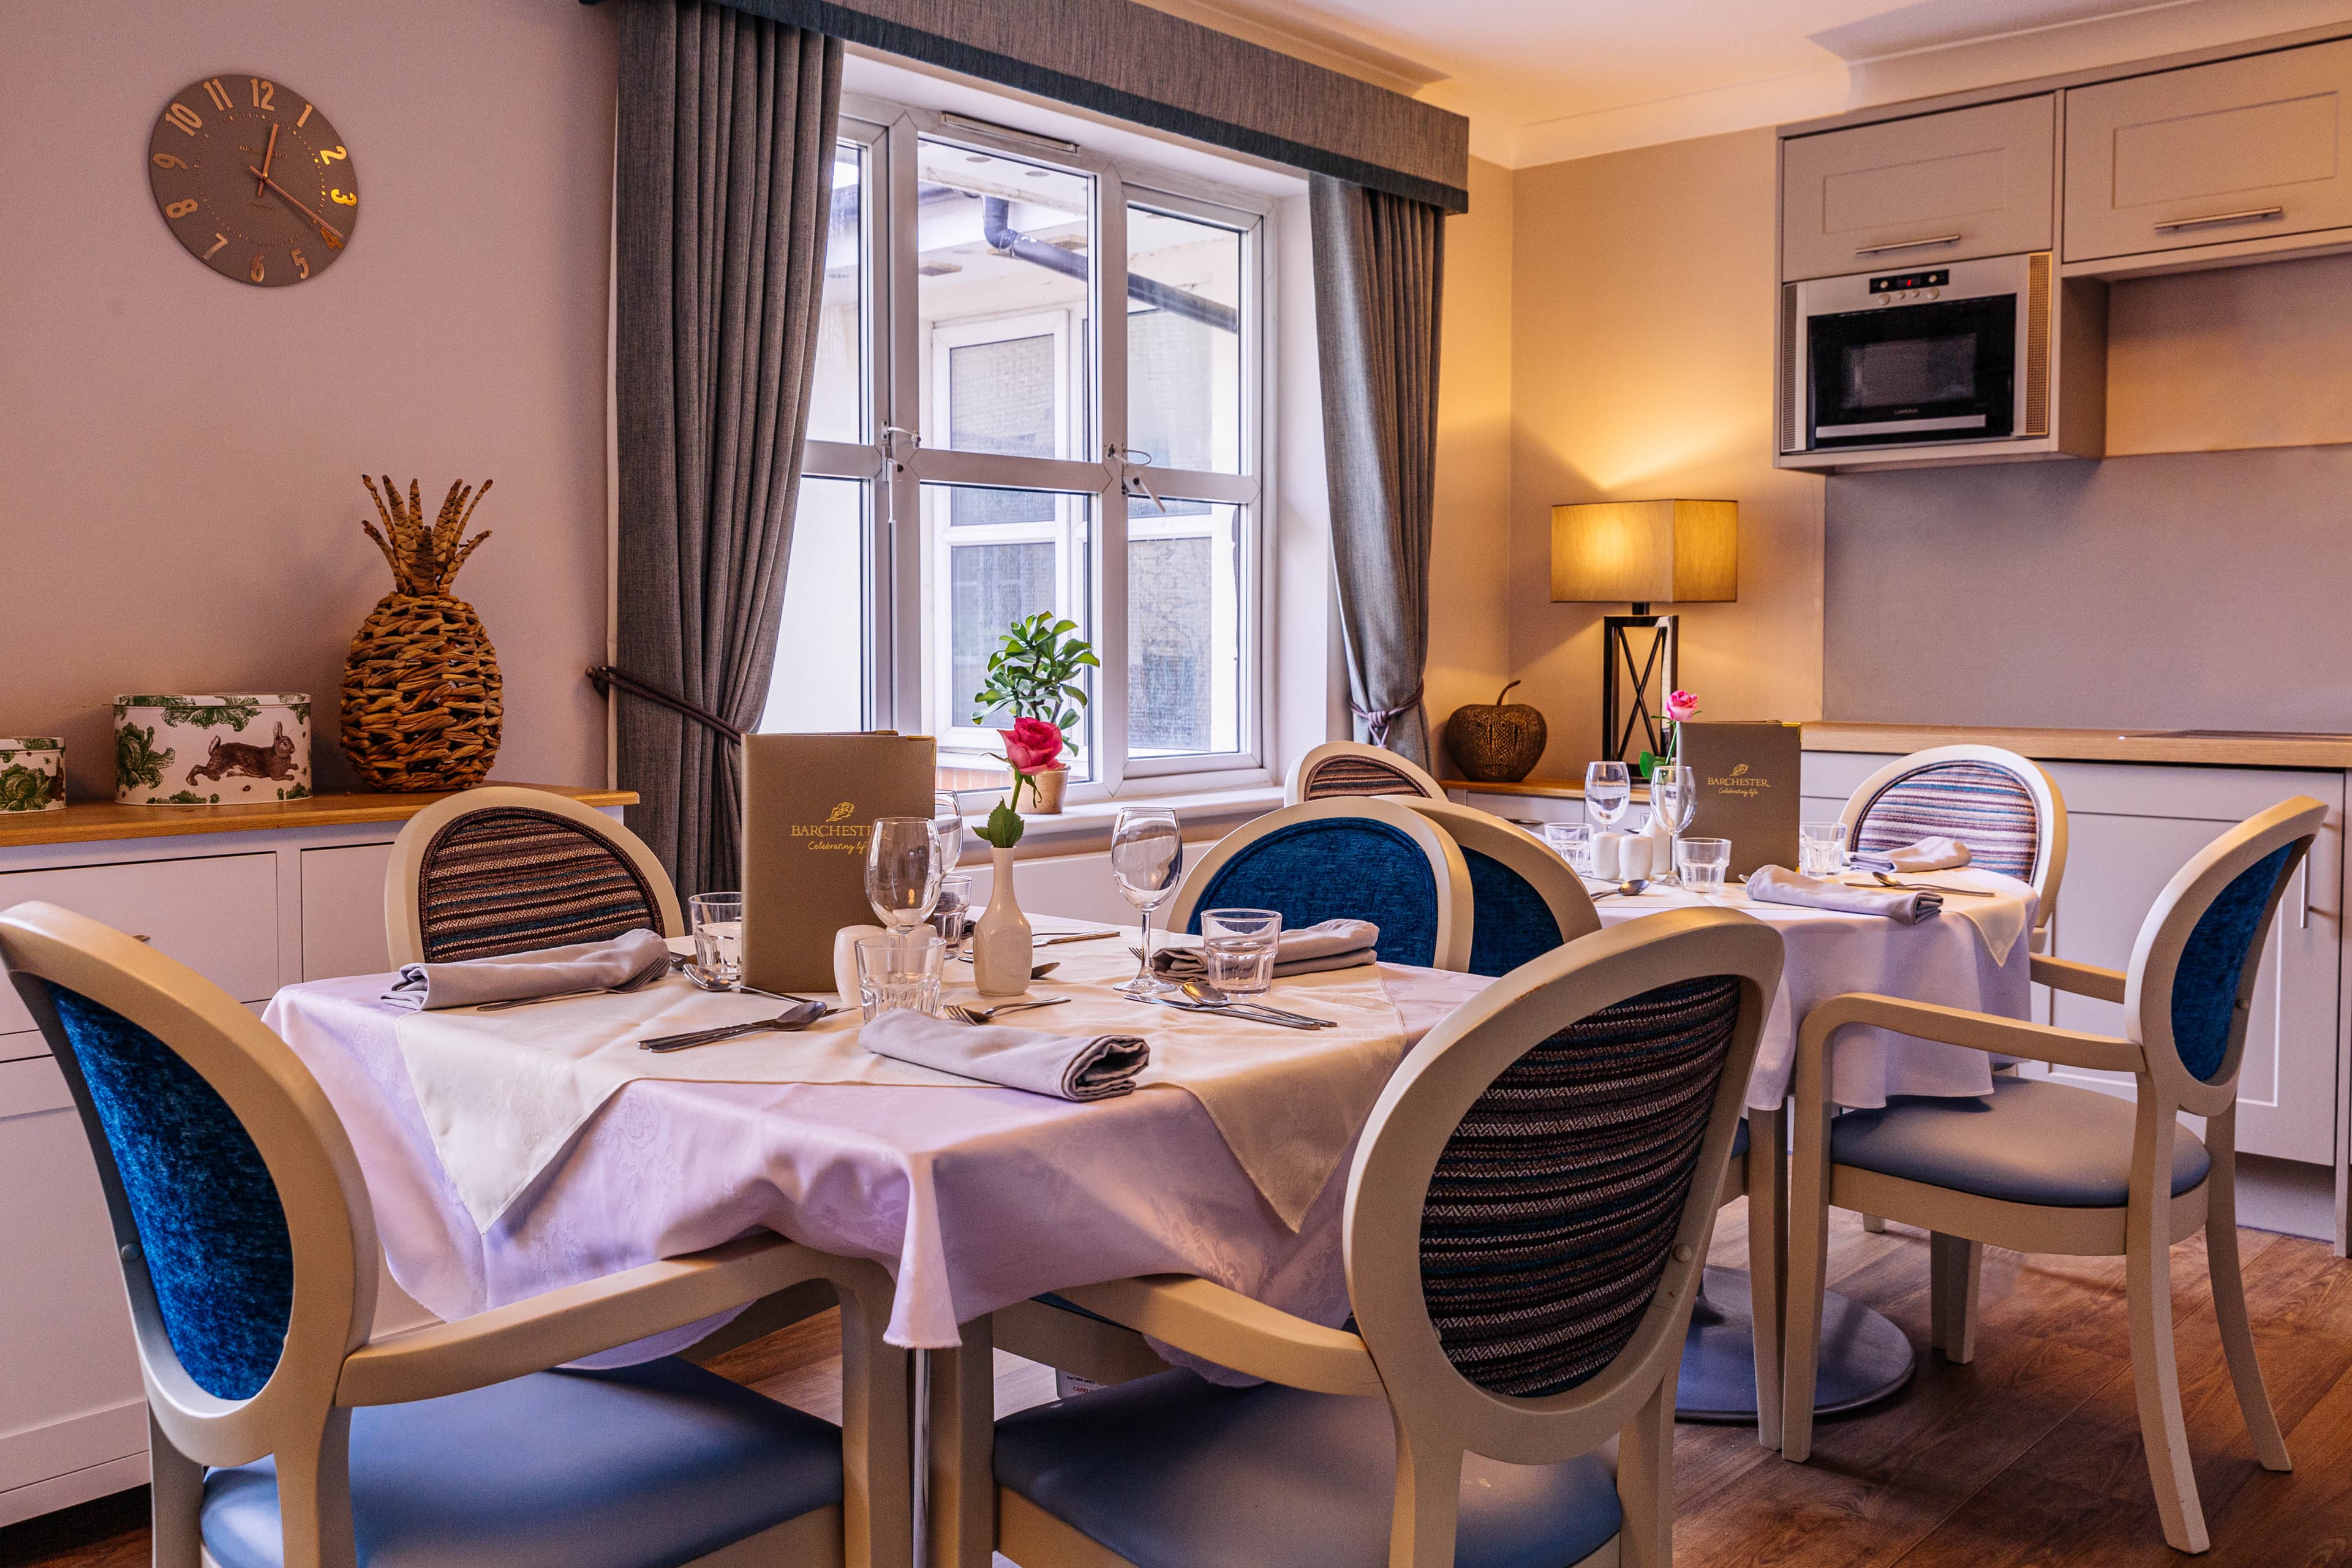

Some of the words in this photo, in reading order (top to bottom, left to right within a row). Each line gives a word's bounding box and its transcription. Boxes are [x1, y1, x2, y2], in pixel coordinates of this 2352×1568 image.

[203, 78, 234, 111] 11
[250, 78, 275, 111] 12
[165, 102, 203, 137] 10
[296, 104, 314, 128] 1
[153, 153, 188, 170] 9
[320, 145, 347, 165] 2
[165, 198, 198, 219] 8
[331, 189, 358, 206] 3
[202, 233, 228, 260] 7
[320, 227, 344, 251] 4
[250, 254, 265, 282] 6
[290, 248, 309, 279] 5
[1708, 777, 1771, 787] BARCHESTER
[1718, 788, 1747, 797] Celebrating
[1749, 788, 1758, 797] life
[809, 841, 855, 854] Celebrating
[856, 841, 867, 854] lif
